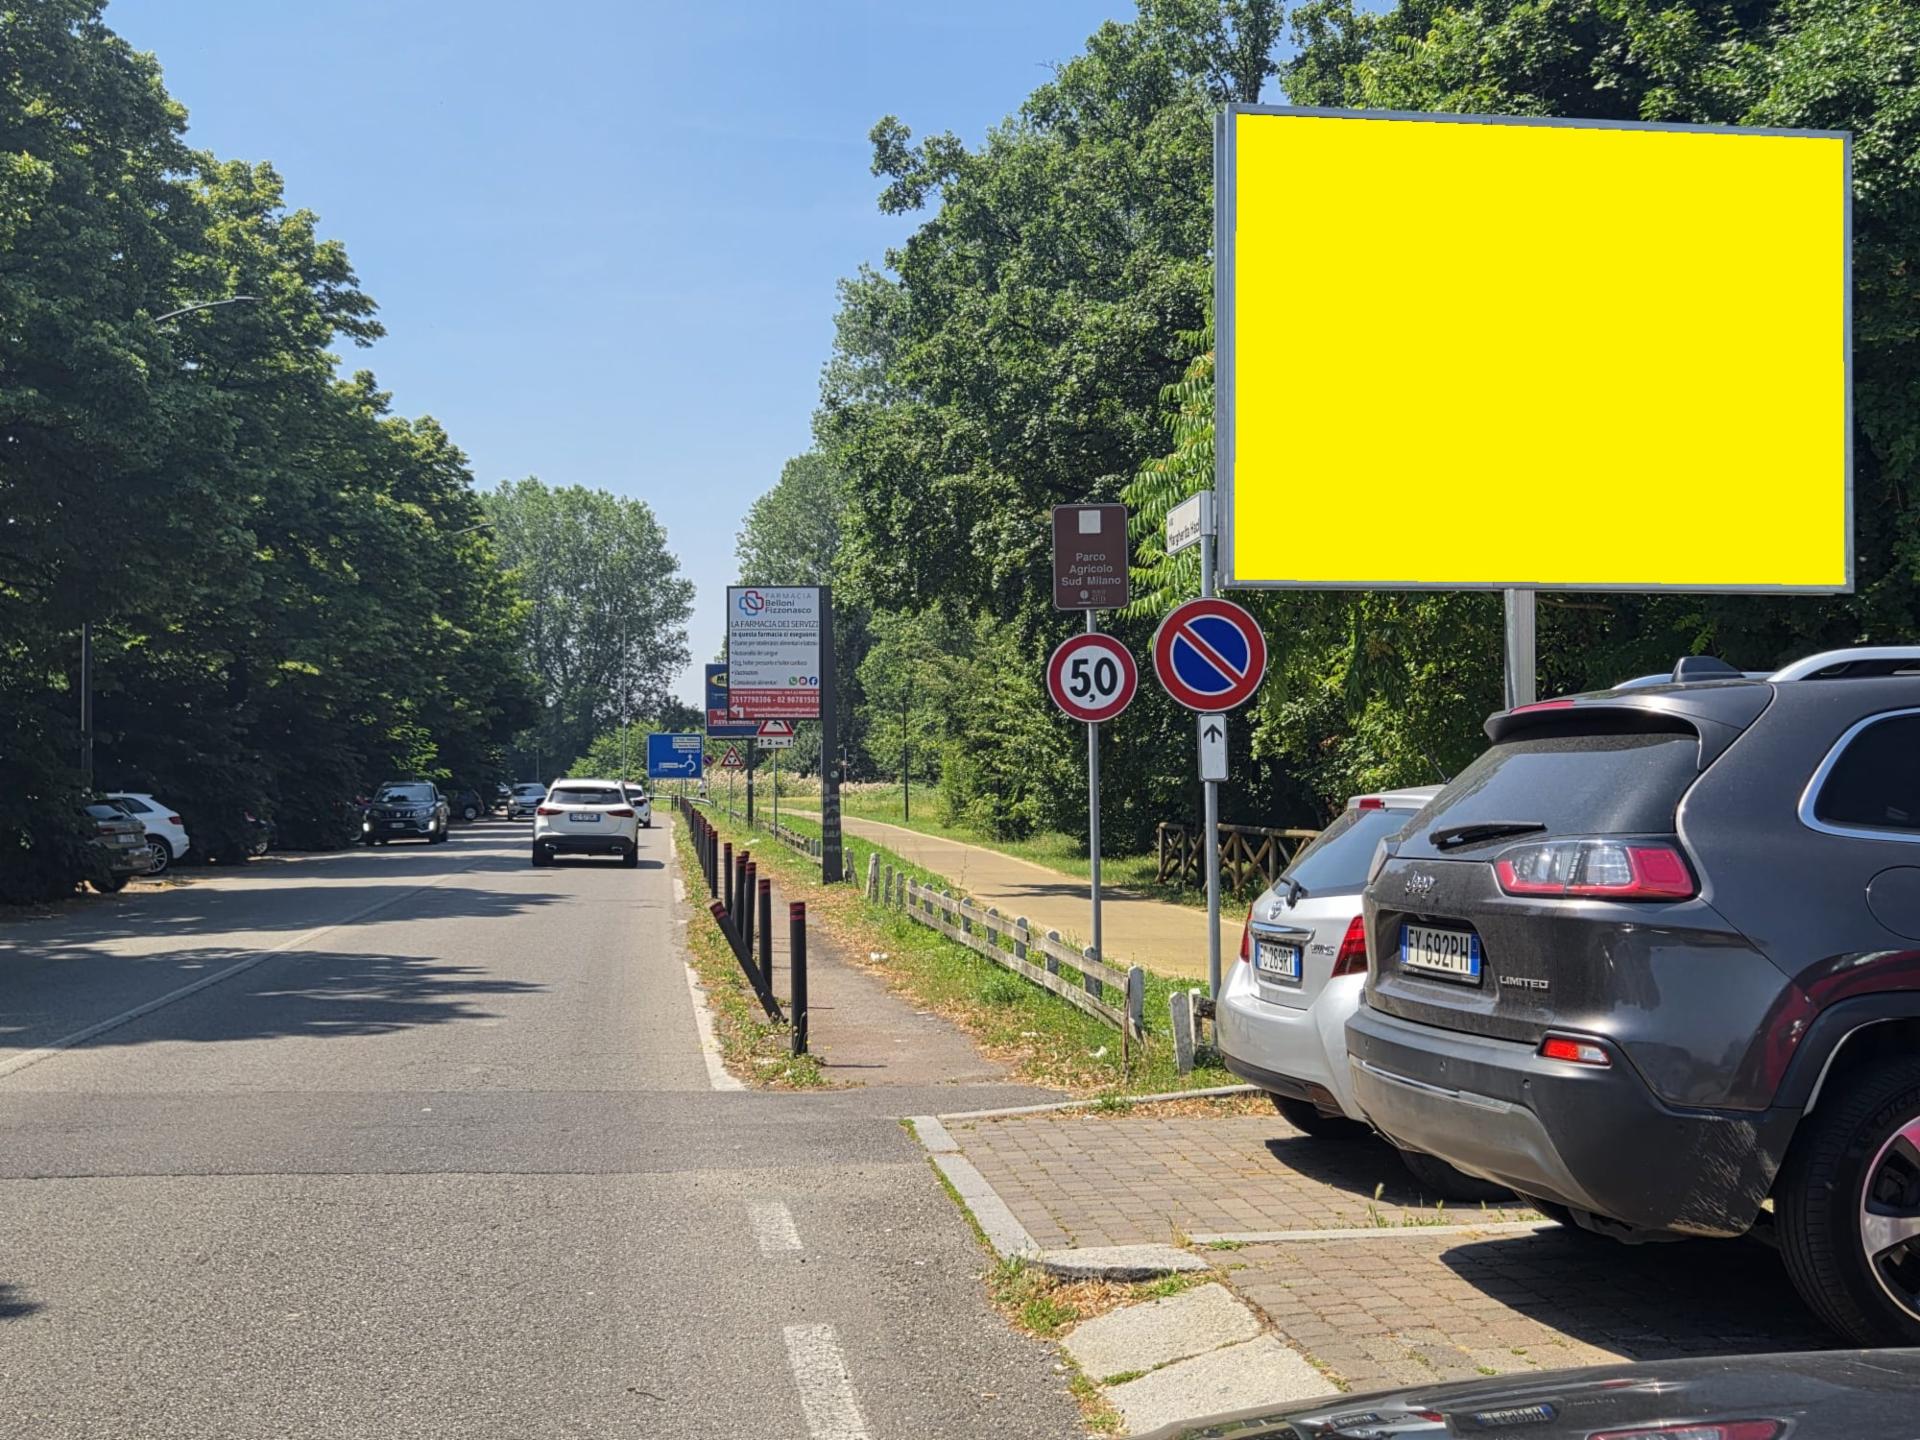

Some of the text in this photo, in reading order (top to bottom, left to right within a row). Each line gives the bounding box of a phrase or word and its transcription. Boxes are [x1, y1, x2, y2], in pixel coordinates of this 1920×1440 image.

[1076, 552, 1106, 562] Parco
[1068, 564, 1113, 576] Agricolo
[1061, 575, 1121, 587] Sud Milano
[765, 599, 795, 607] Belloni
[731, 620, 739, 628] LA
[740, 620, 777, 628] FARMACIA
[777, 620, 789, 628] DEI
[767, 738, 772, 746] 2
[1405, 870, 1435, 896] Jeep
[1500, 975, 1550, 990] LIMITED
